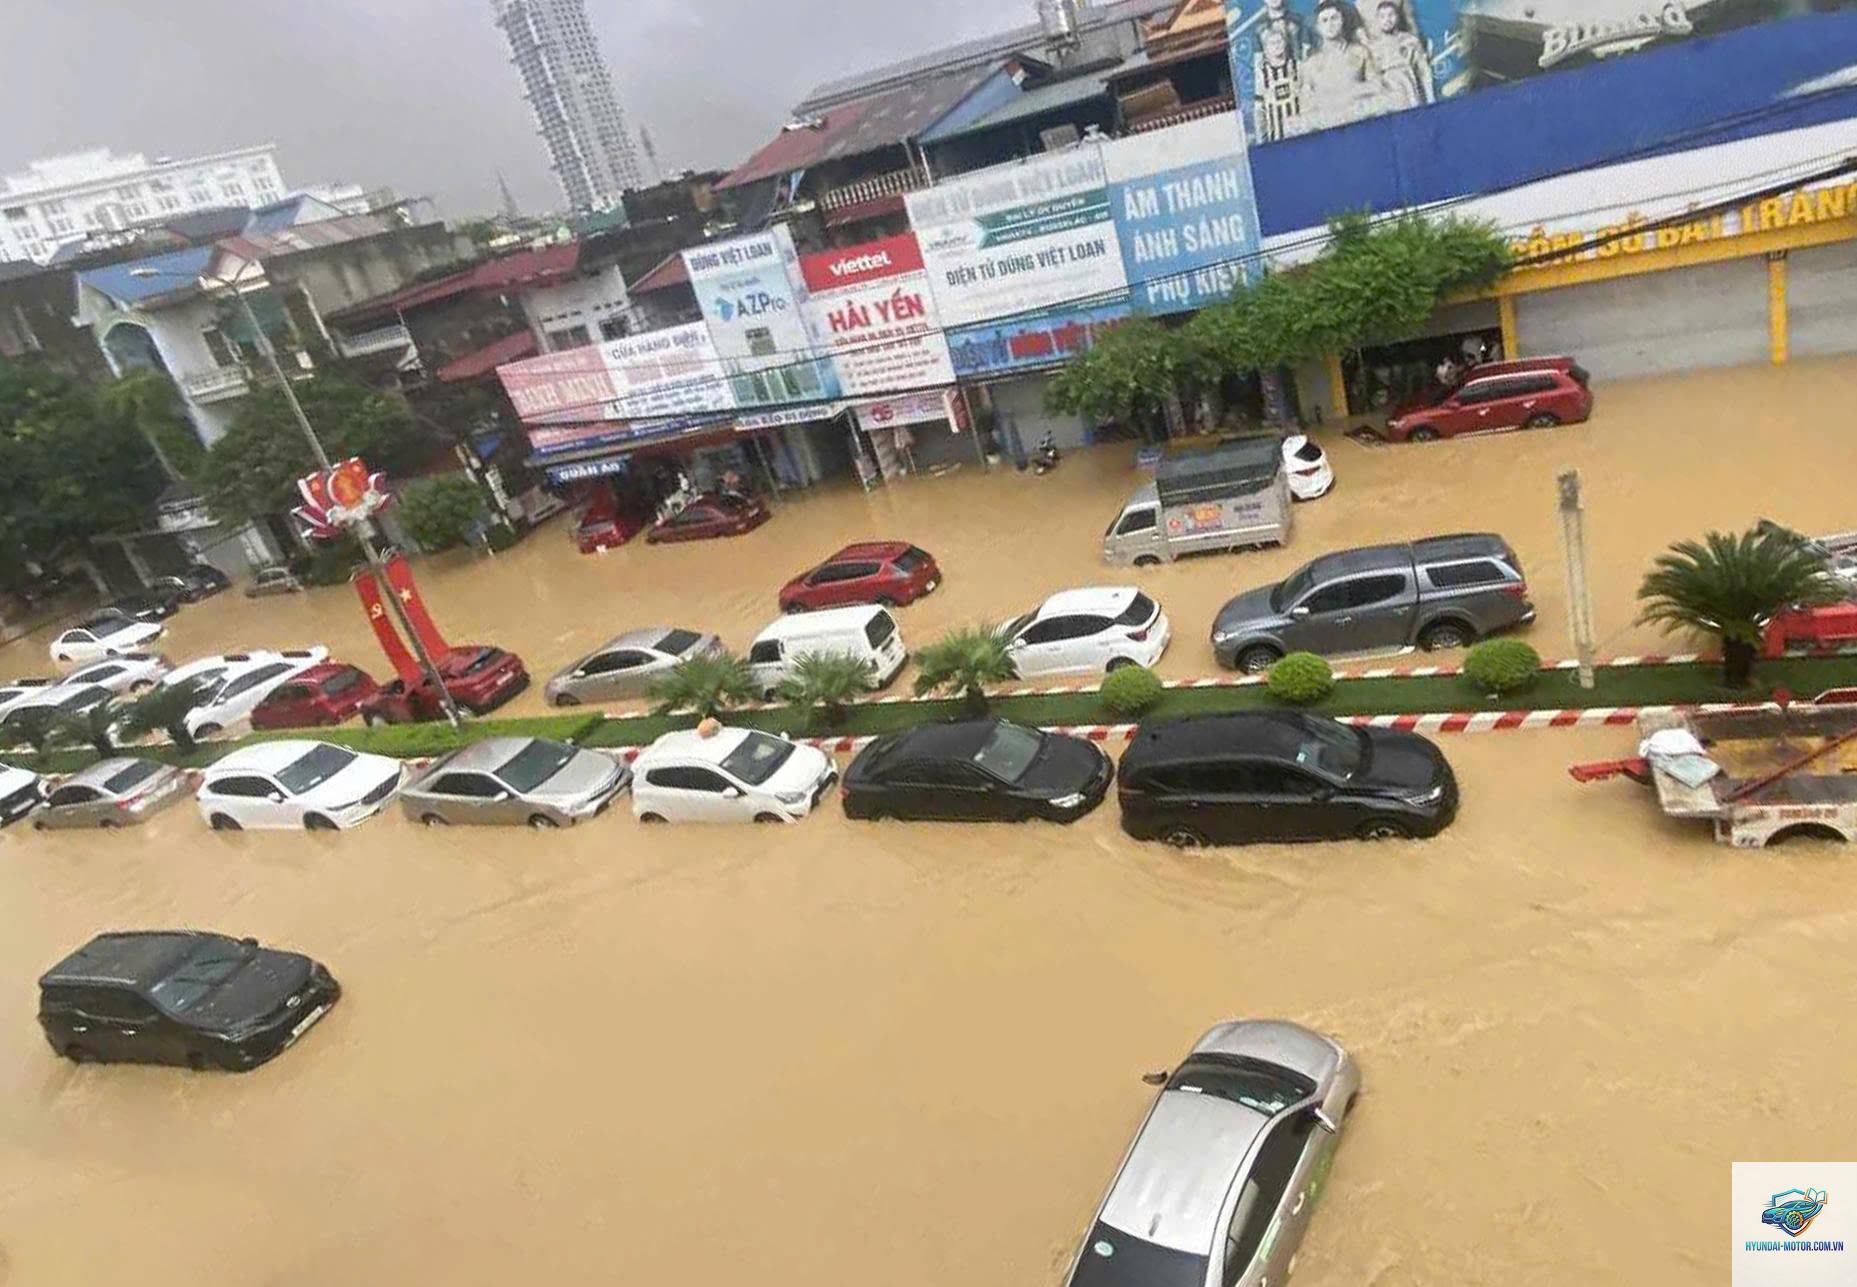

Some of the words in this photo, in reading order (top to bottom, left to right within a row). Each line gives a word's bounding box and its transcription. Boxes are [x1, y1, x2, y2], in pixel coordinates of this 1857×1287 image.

[1123, 185, 1159, 220] ÂM
[1162, 169, 1239, 214] THANH
[745, 241, 773, 260] LOAN
[1133, 228, 1179, 263] ÁNH
[1183, 212, 1245, 252] SÁNG
[828, 250, 892, 277] viettel
[999, 255, 1035, 276] DŨNG
[1036, 247, 1067, 269] VIỆT
[1069, 239, 1106, 261] LOAN
[1146, 275, 1190, 305] PHỤ
[827, 299, 872, 333] HẢI
[873, 287, 926, 323] YẾN
